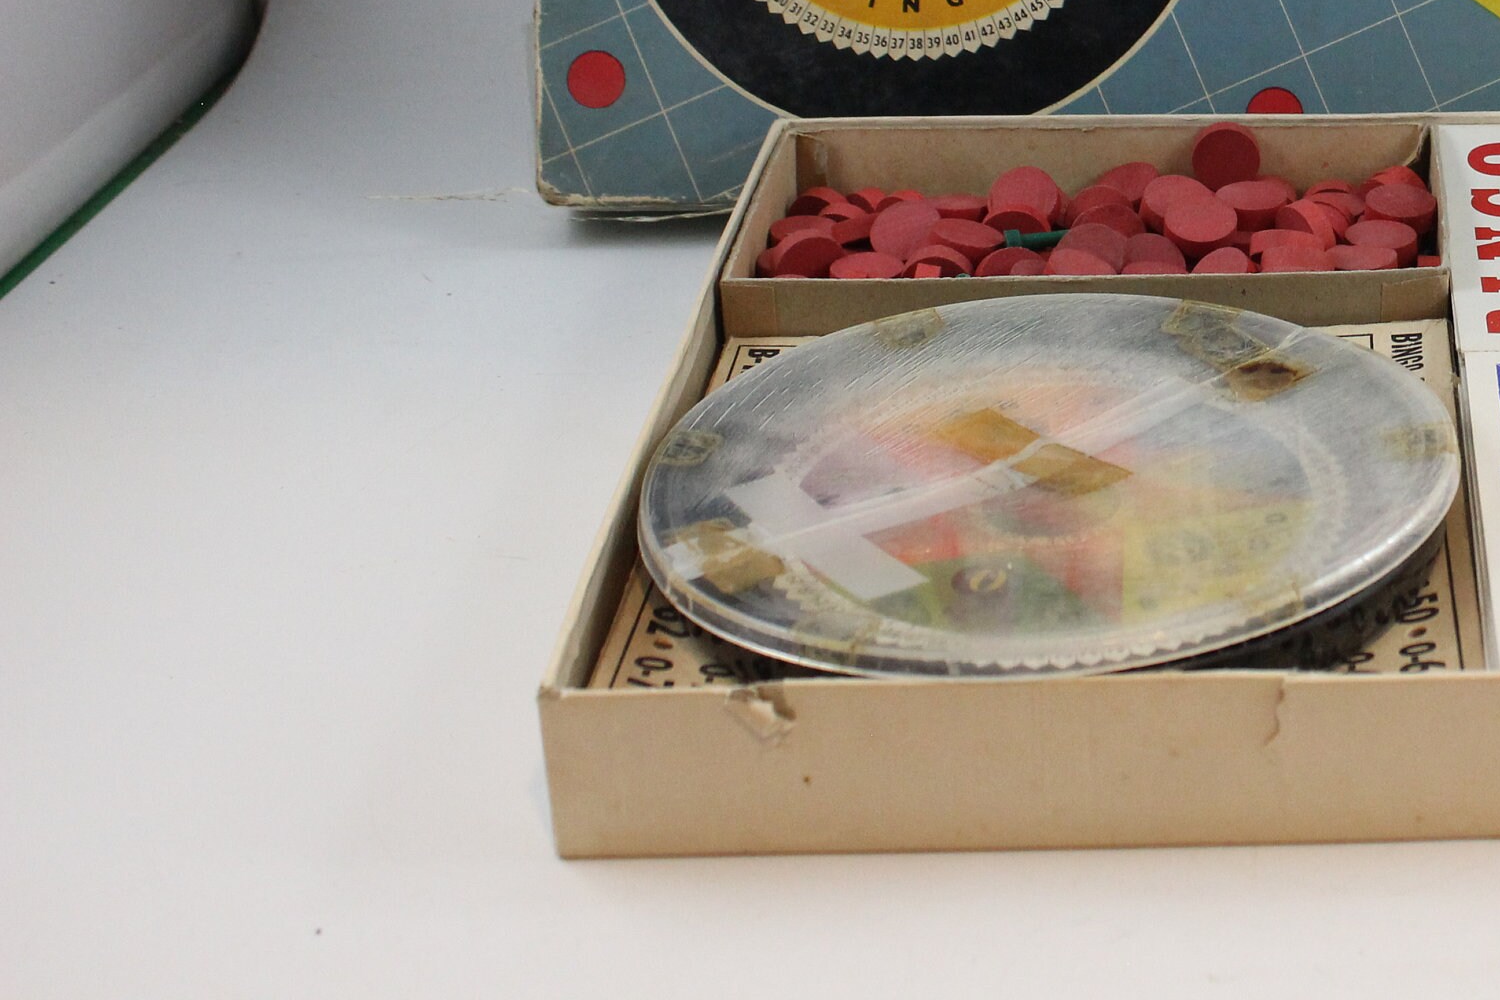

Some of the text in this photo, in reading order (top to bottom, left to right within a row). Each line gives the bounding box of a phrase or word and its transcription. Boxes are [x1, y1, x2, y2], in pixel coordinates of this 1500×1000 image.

[788, 2, 803, 16] 31
[1014, 8, 1029, 22] 44
[803, 11, 819, 27] 32
[998, 16, 1013, 31] 43
[820, 19, 836, 34] 33
[837, 25, 853, 40] 34
[980, 23, 996, 37] 42
[855, 31, 870, 45] 35
[873, 34, 888, 48] 36
[927, 36, 941, 49] 39
[945, 33, 960, 46] 40
[964, 29, 976, 42] 41
[890, 37, 905, 50] 37
[909, 37, 924, 50] 38
